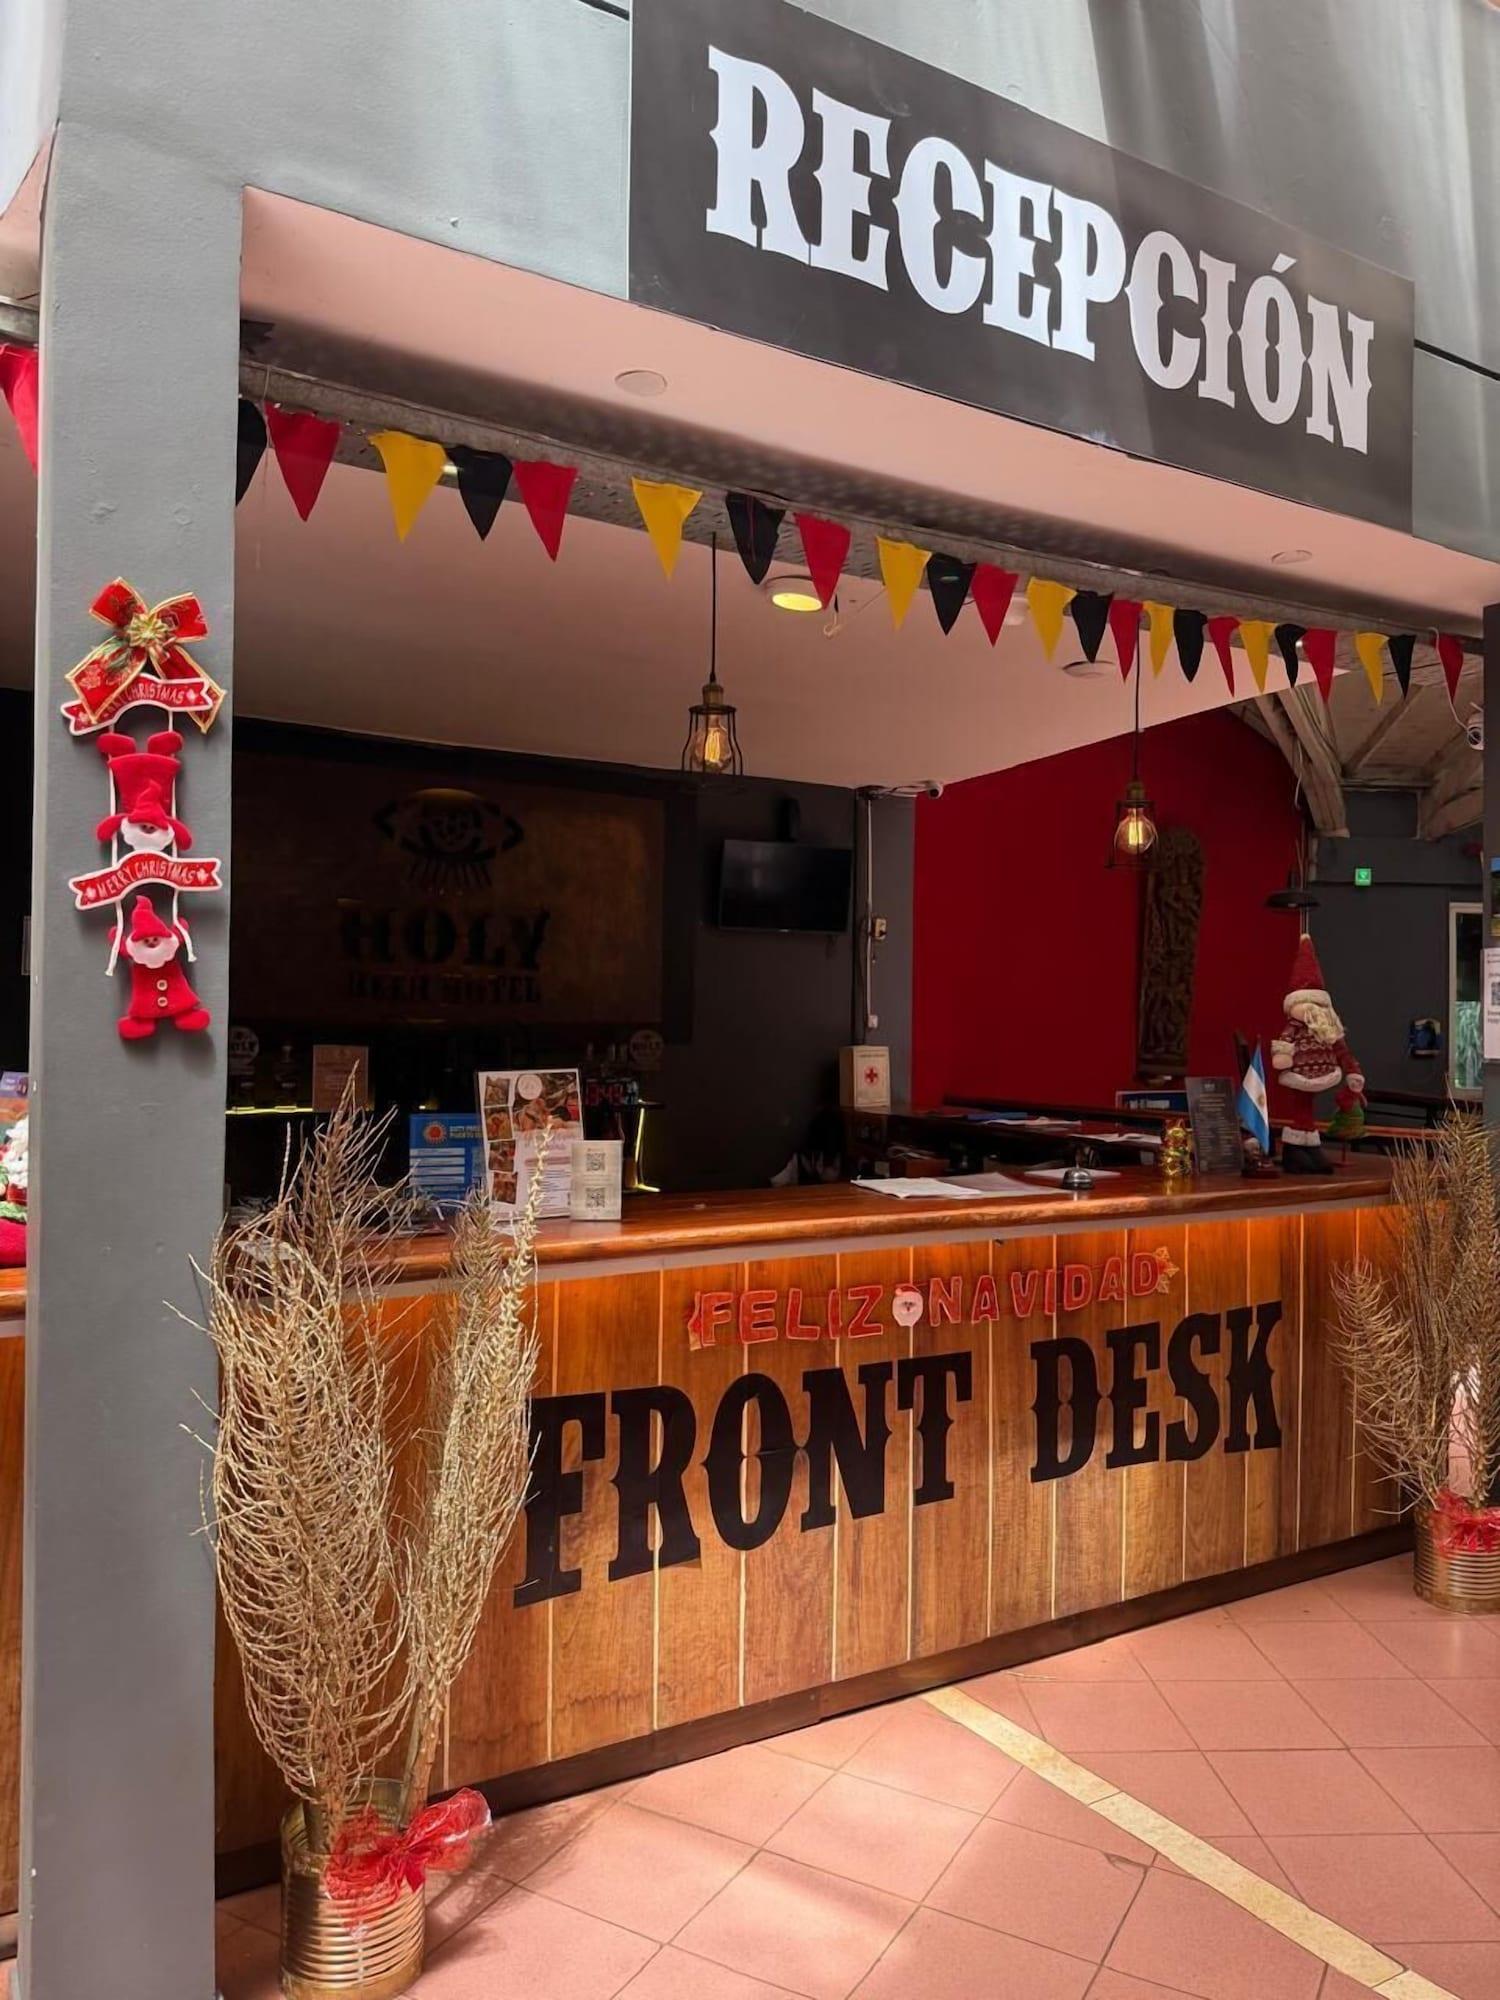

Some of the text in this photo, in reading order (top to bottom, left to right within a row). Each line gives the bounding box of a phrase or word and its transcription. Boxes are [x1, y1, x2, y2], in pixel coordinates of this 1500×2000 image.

[706, 44, 1374, 454] RECEPCIÓN
[96, 860, 197, 898] MERRY CHRISTMAS
[338, 906, 552, 971] HOLY
[701, 1252, 1162, 1347] FELIZ NAVIDAD
[513, 1301, 1284, 1609] FRONT DESK
